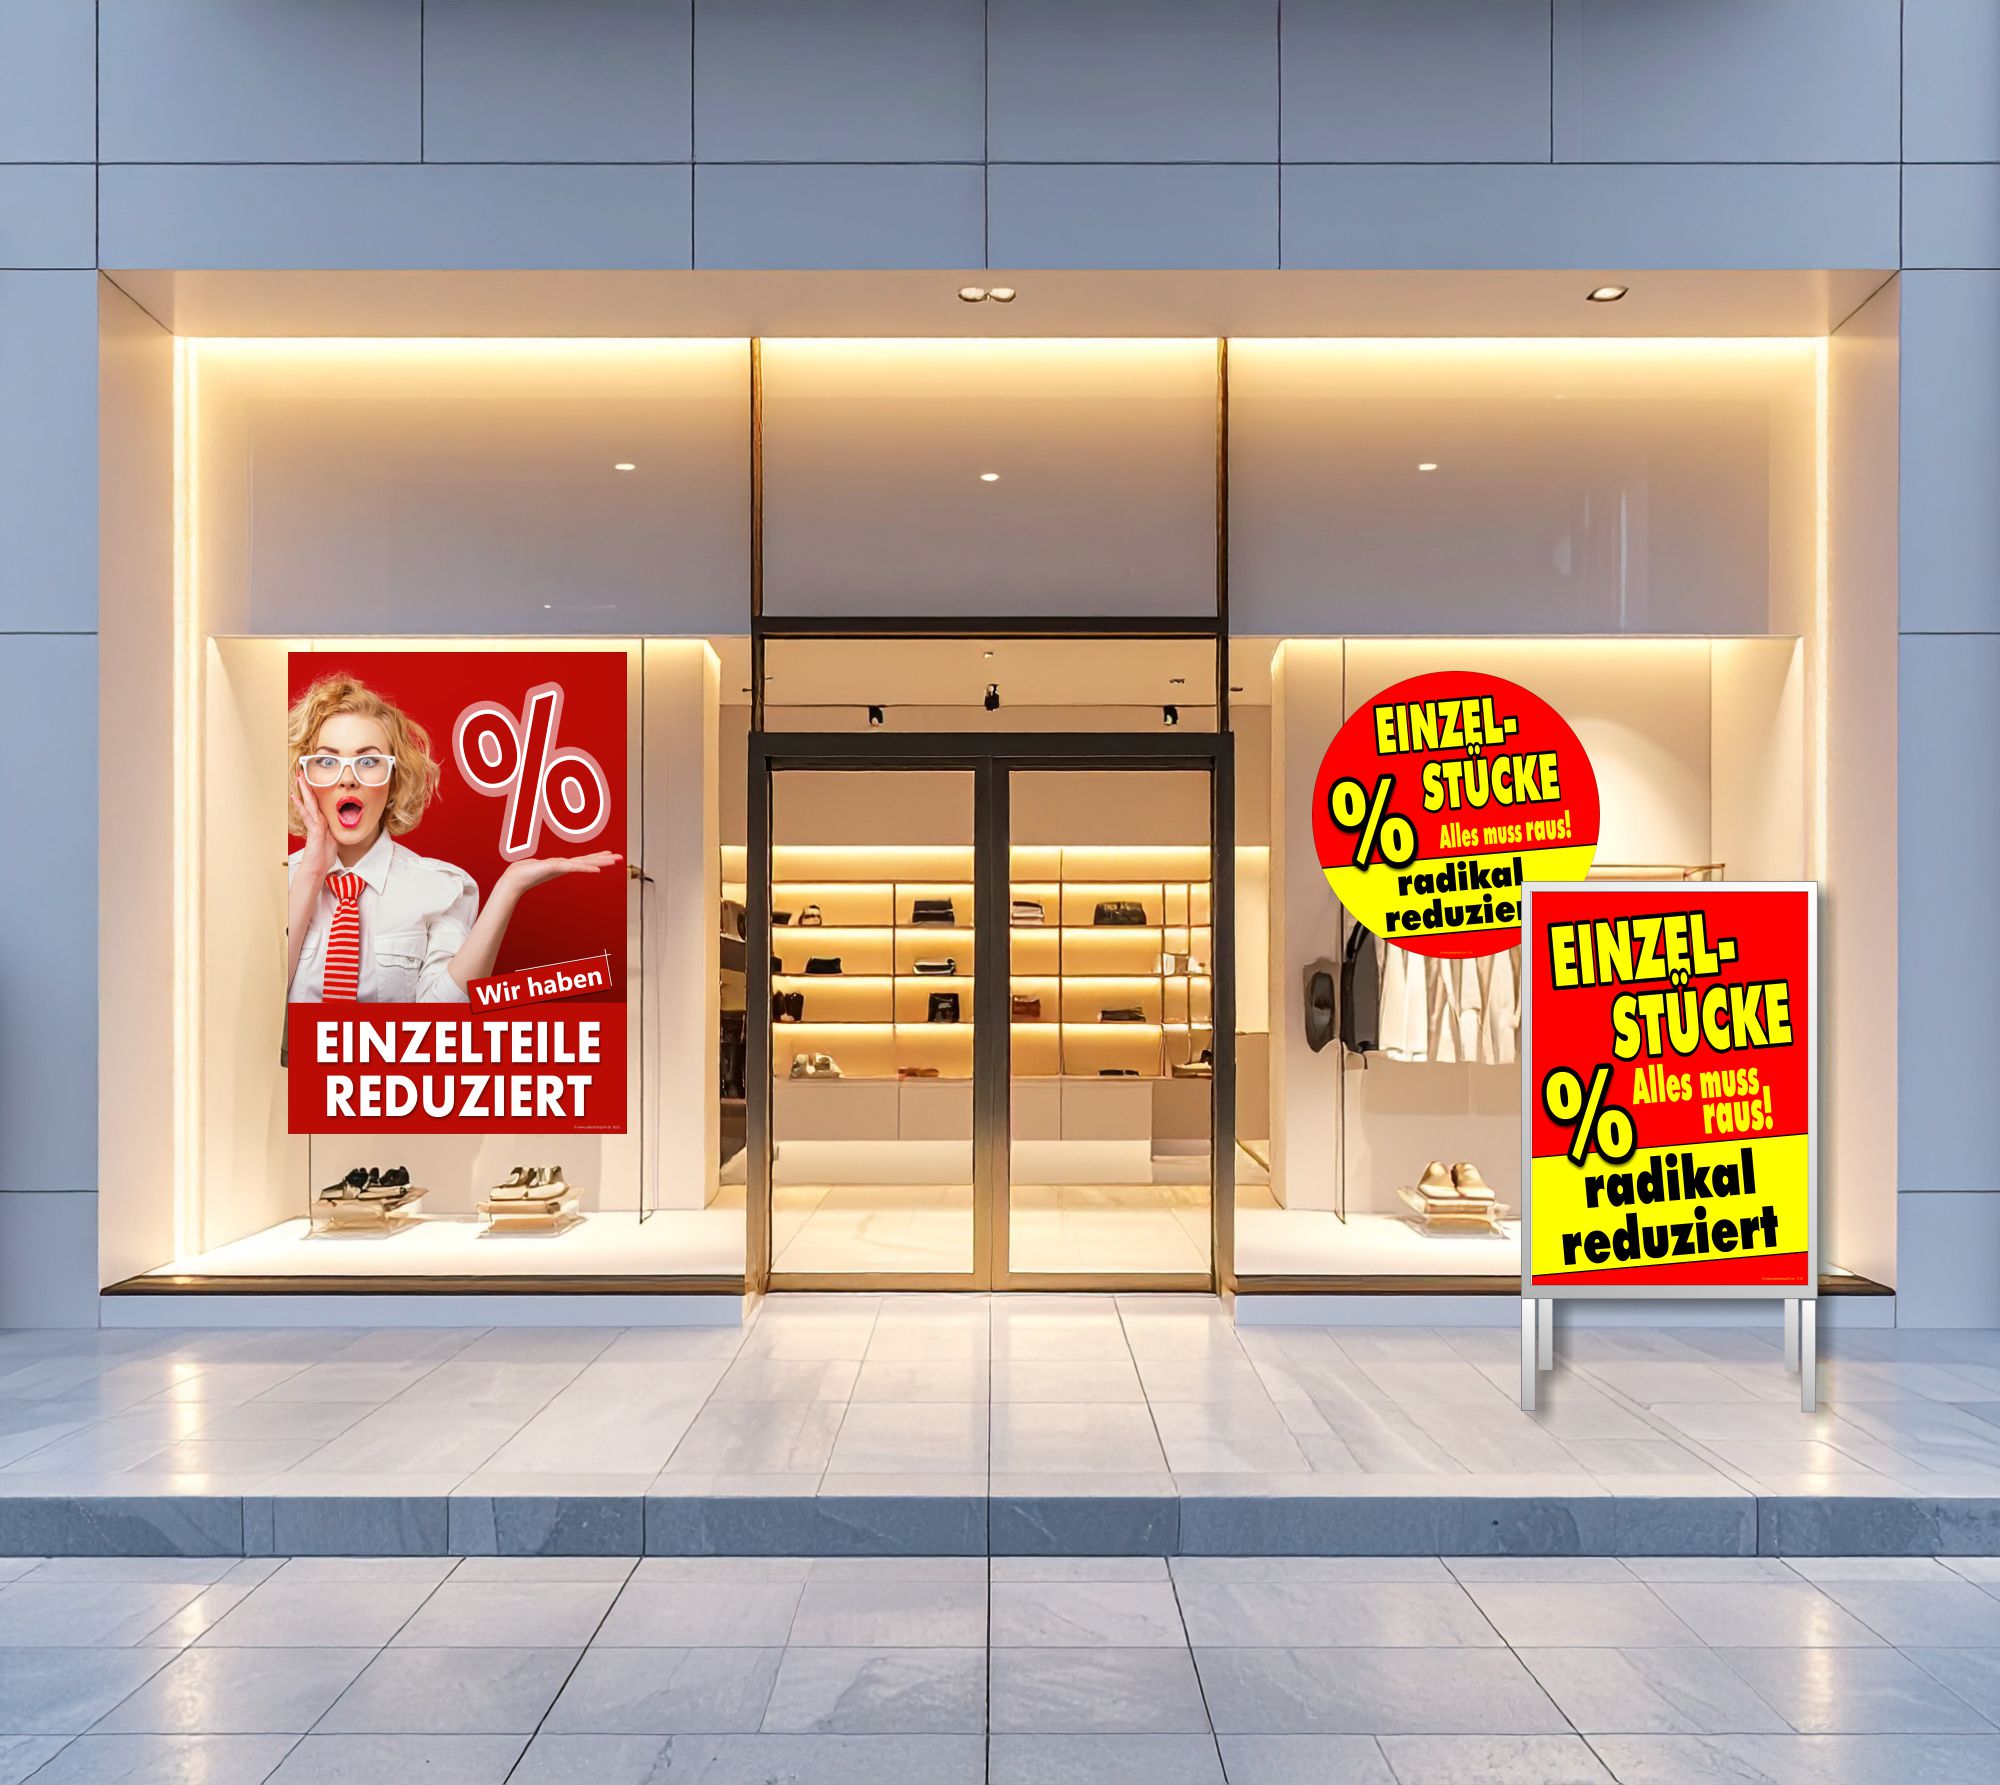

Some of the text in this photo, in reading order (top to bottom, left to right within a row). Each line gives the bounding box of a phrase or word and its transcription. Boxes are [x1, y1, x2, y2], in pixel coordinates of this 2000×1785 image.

[1373, 695, 1518, 756] EINZEL-
[455, 682, 608, 860] %
[1422, 742, 1560, 812] STÜCKE
[1328, 774, 1418, 871] %
[1439, 810, 1572, 849] Alles muss raus!
[1398, 857, 1524, 896] radikal
[1547, 910, 1739, 991] EINZEL-
[476, 967, 602, 1005] Wir haben
[1611, 969, 1793, 1060] STÜCKE
[316, 1021, 600, 1063] EINZELTEILE
[325, 1074, 592, 1117] REDUZIERT
[1633, 1064, 1759, 1105] Alles muss
[1703, 1085, 1774, 1134] raus!
[1542, 1064, 1638, 1167] %
[1585, 1147, 1756, 1208] radikal
[1562, 1205, 1778, 1265] reduziert
